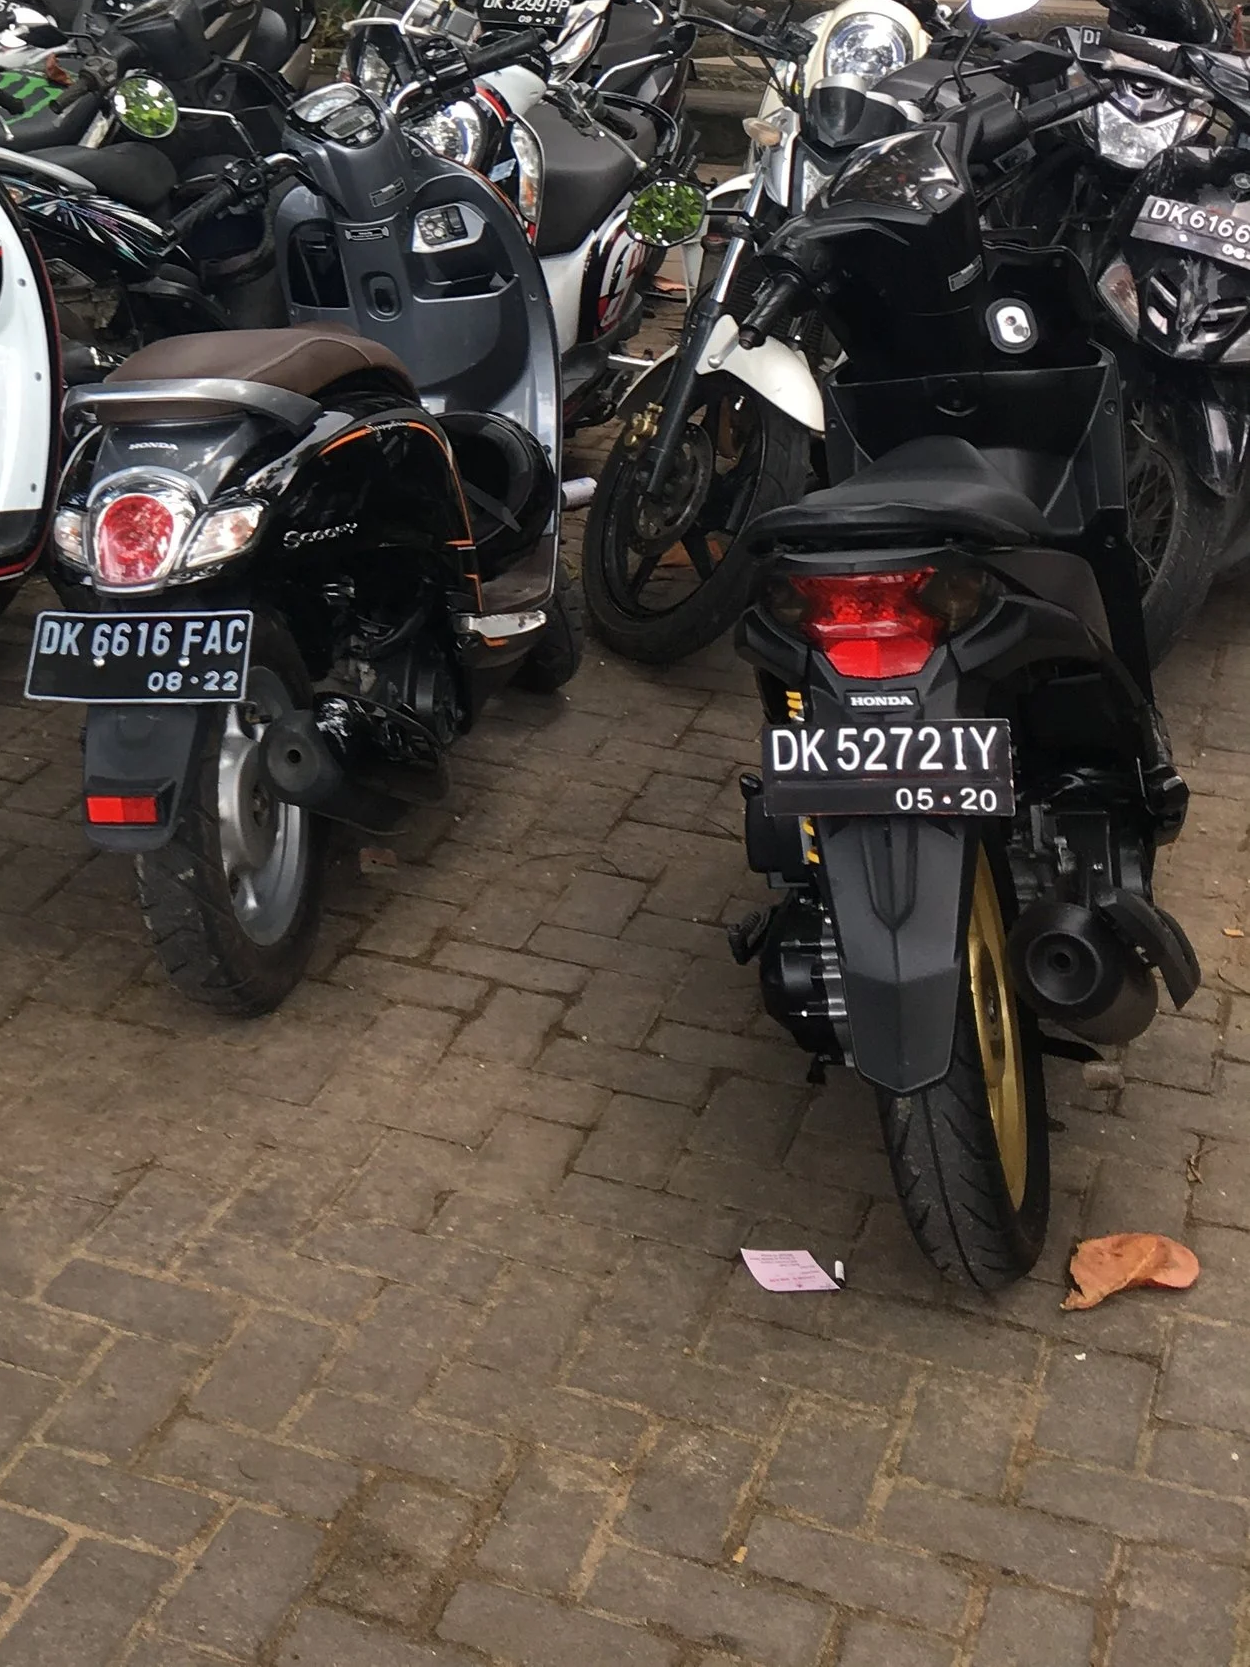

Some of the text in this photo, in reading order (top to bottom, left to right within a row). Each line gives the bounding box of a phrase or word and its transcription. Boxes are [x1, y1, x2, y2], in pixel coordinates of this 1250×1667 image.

[1150, 200, 1250, 243] DK 6166
[128, 441, 179, 451] HONDA
[283, 522, 358, 549] Scoopy
[39, 619, 246, 657] DK 6616 FAC
[850, 696, 914, 707] HONDA
[771, 726, 998, 772] DK 5272 IY
